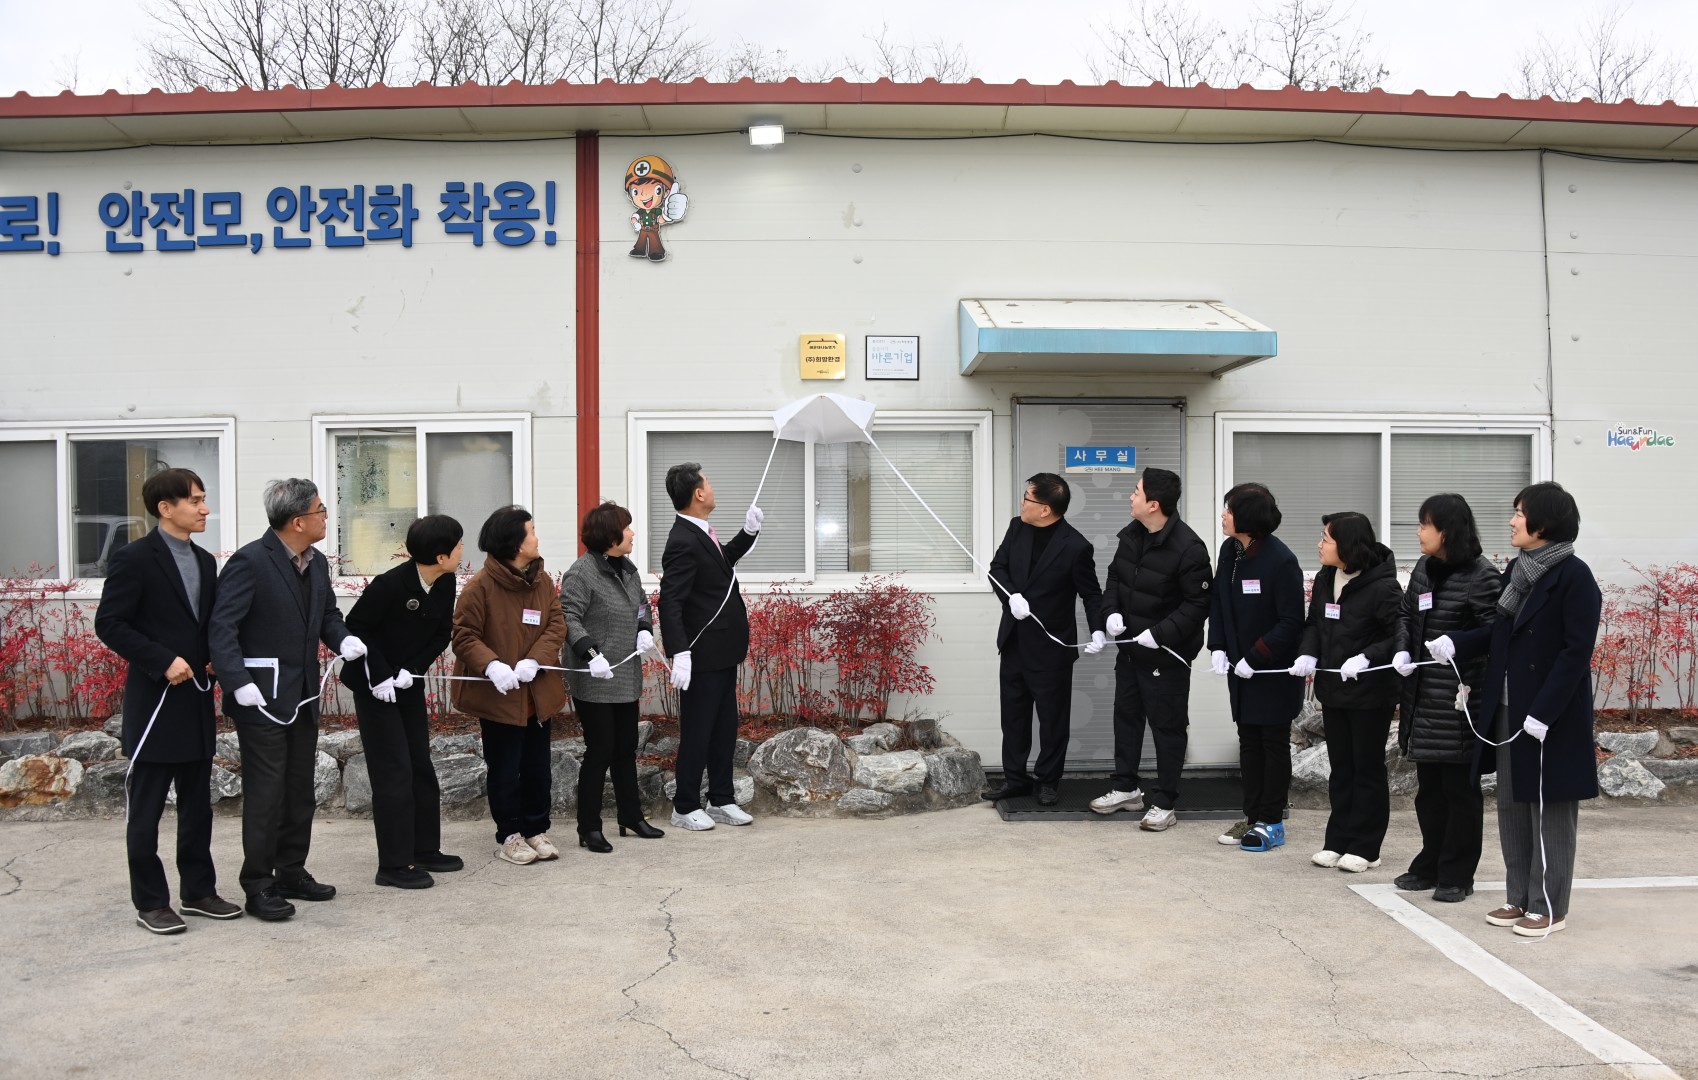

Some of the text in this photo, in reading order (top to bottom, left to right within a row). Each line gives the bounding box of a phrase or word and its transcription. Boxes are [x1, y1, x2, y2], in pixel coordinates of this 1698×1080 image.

[0, 192, 60, 254] 로!
[437, 181, 556, 247] 착용!
[1608, 430, 1674, 450] Haeundae
[1617, 426, 1653, 435] Sun&Fun
